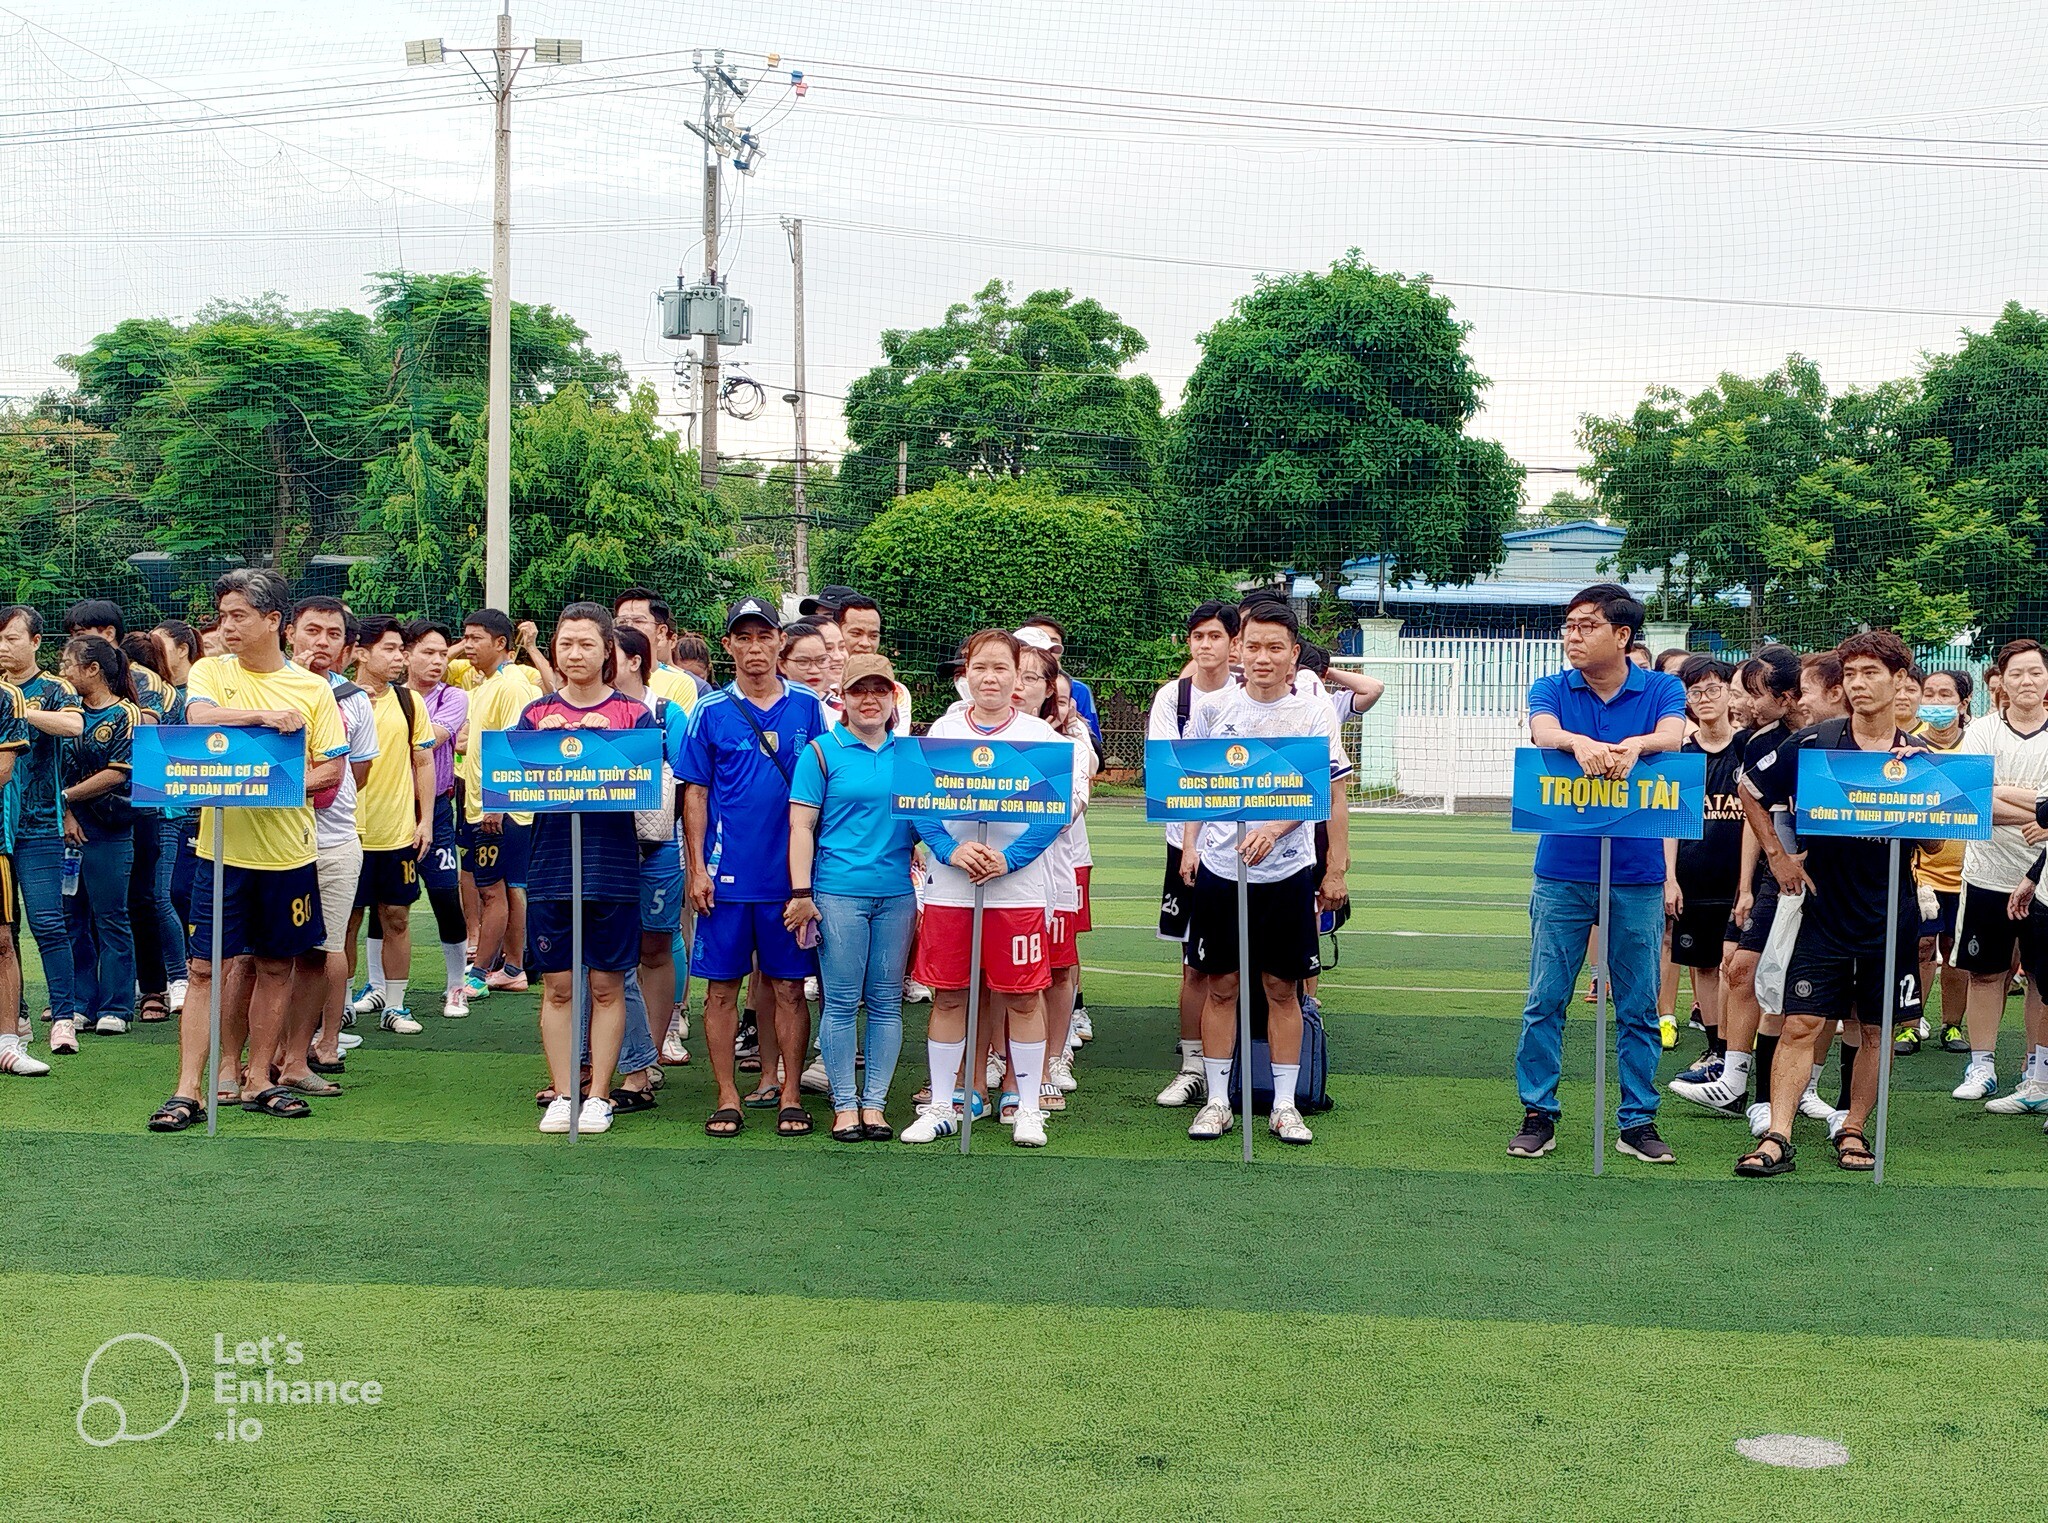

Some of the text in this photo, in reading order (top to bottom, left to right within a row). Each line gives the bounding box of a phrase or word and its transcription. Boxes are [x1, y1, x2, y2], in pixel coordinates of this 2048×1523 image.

[166, 762, 198, 777] CÔNG
[524, 770, 545, 782] CTY
[164, 782, 188, 798] TẬP
[245, 784, 268, 796] LAN
[934, 774, 964, 789] CÔNG
[1210, 774, 1240, 790] CÔNG
[1241, 776, 1254, 789] TY
[508, 786, 636, 804] THÔNG THUẬN TRÀ VINH
[1166, 794, 1314, 809] RYNAN SMART AGRICULTURE
[1539, 774, 1680, 814] TRỌNG TÀI
[1848, 790, 1876, 804] CÔNG
[898, 796, 916, 809] CTY
[978, 799, 1000, 812] MAY
[1001, 800, 1024, 813] SOFA
[1026, 801, 1044, 814] HOA
[1046, 802, 1066, 814] SEN
[1810, 806, 1979, 826] CÔNG TY TNHH MTV PCT VIỆT NAM
[435, 848, 457, 871] 26
[477, 845, 499, 868] 89
[401, 860, 416, 885] 18
[650, 889, 666, 915] 5
[1162, 893, 1180, 917] 26
[1012, 932, 1042, 966] 08
